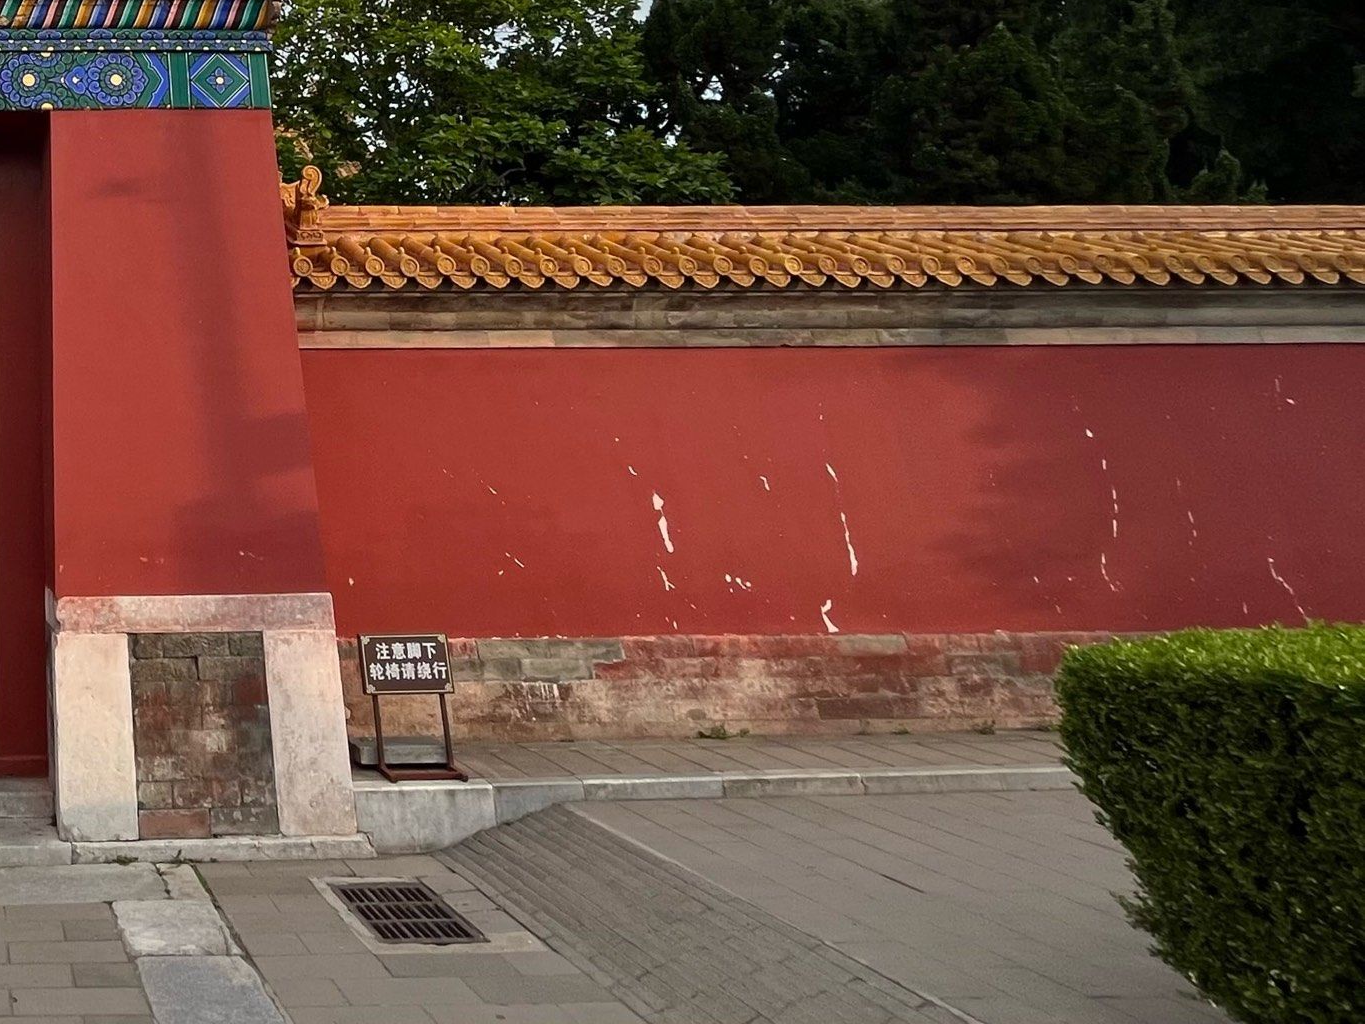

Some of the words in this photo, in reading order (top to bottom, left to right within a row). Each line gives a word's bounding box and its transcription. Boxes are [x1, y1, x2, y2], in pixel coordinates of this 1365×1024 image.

[375, 642, 436, 659] 注意脚下
[369, 661, 447, 680] 轮椅请绕行
